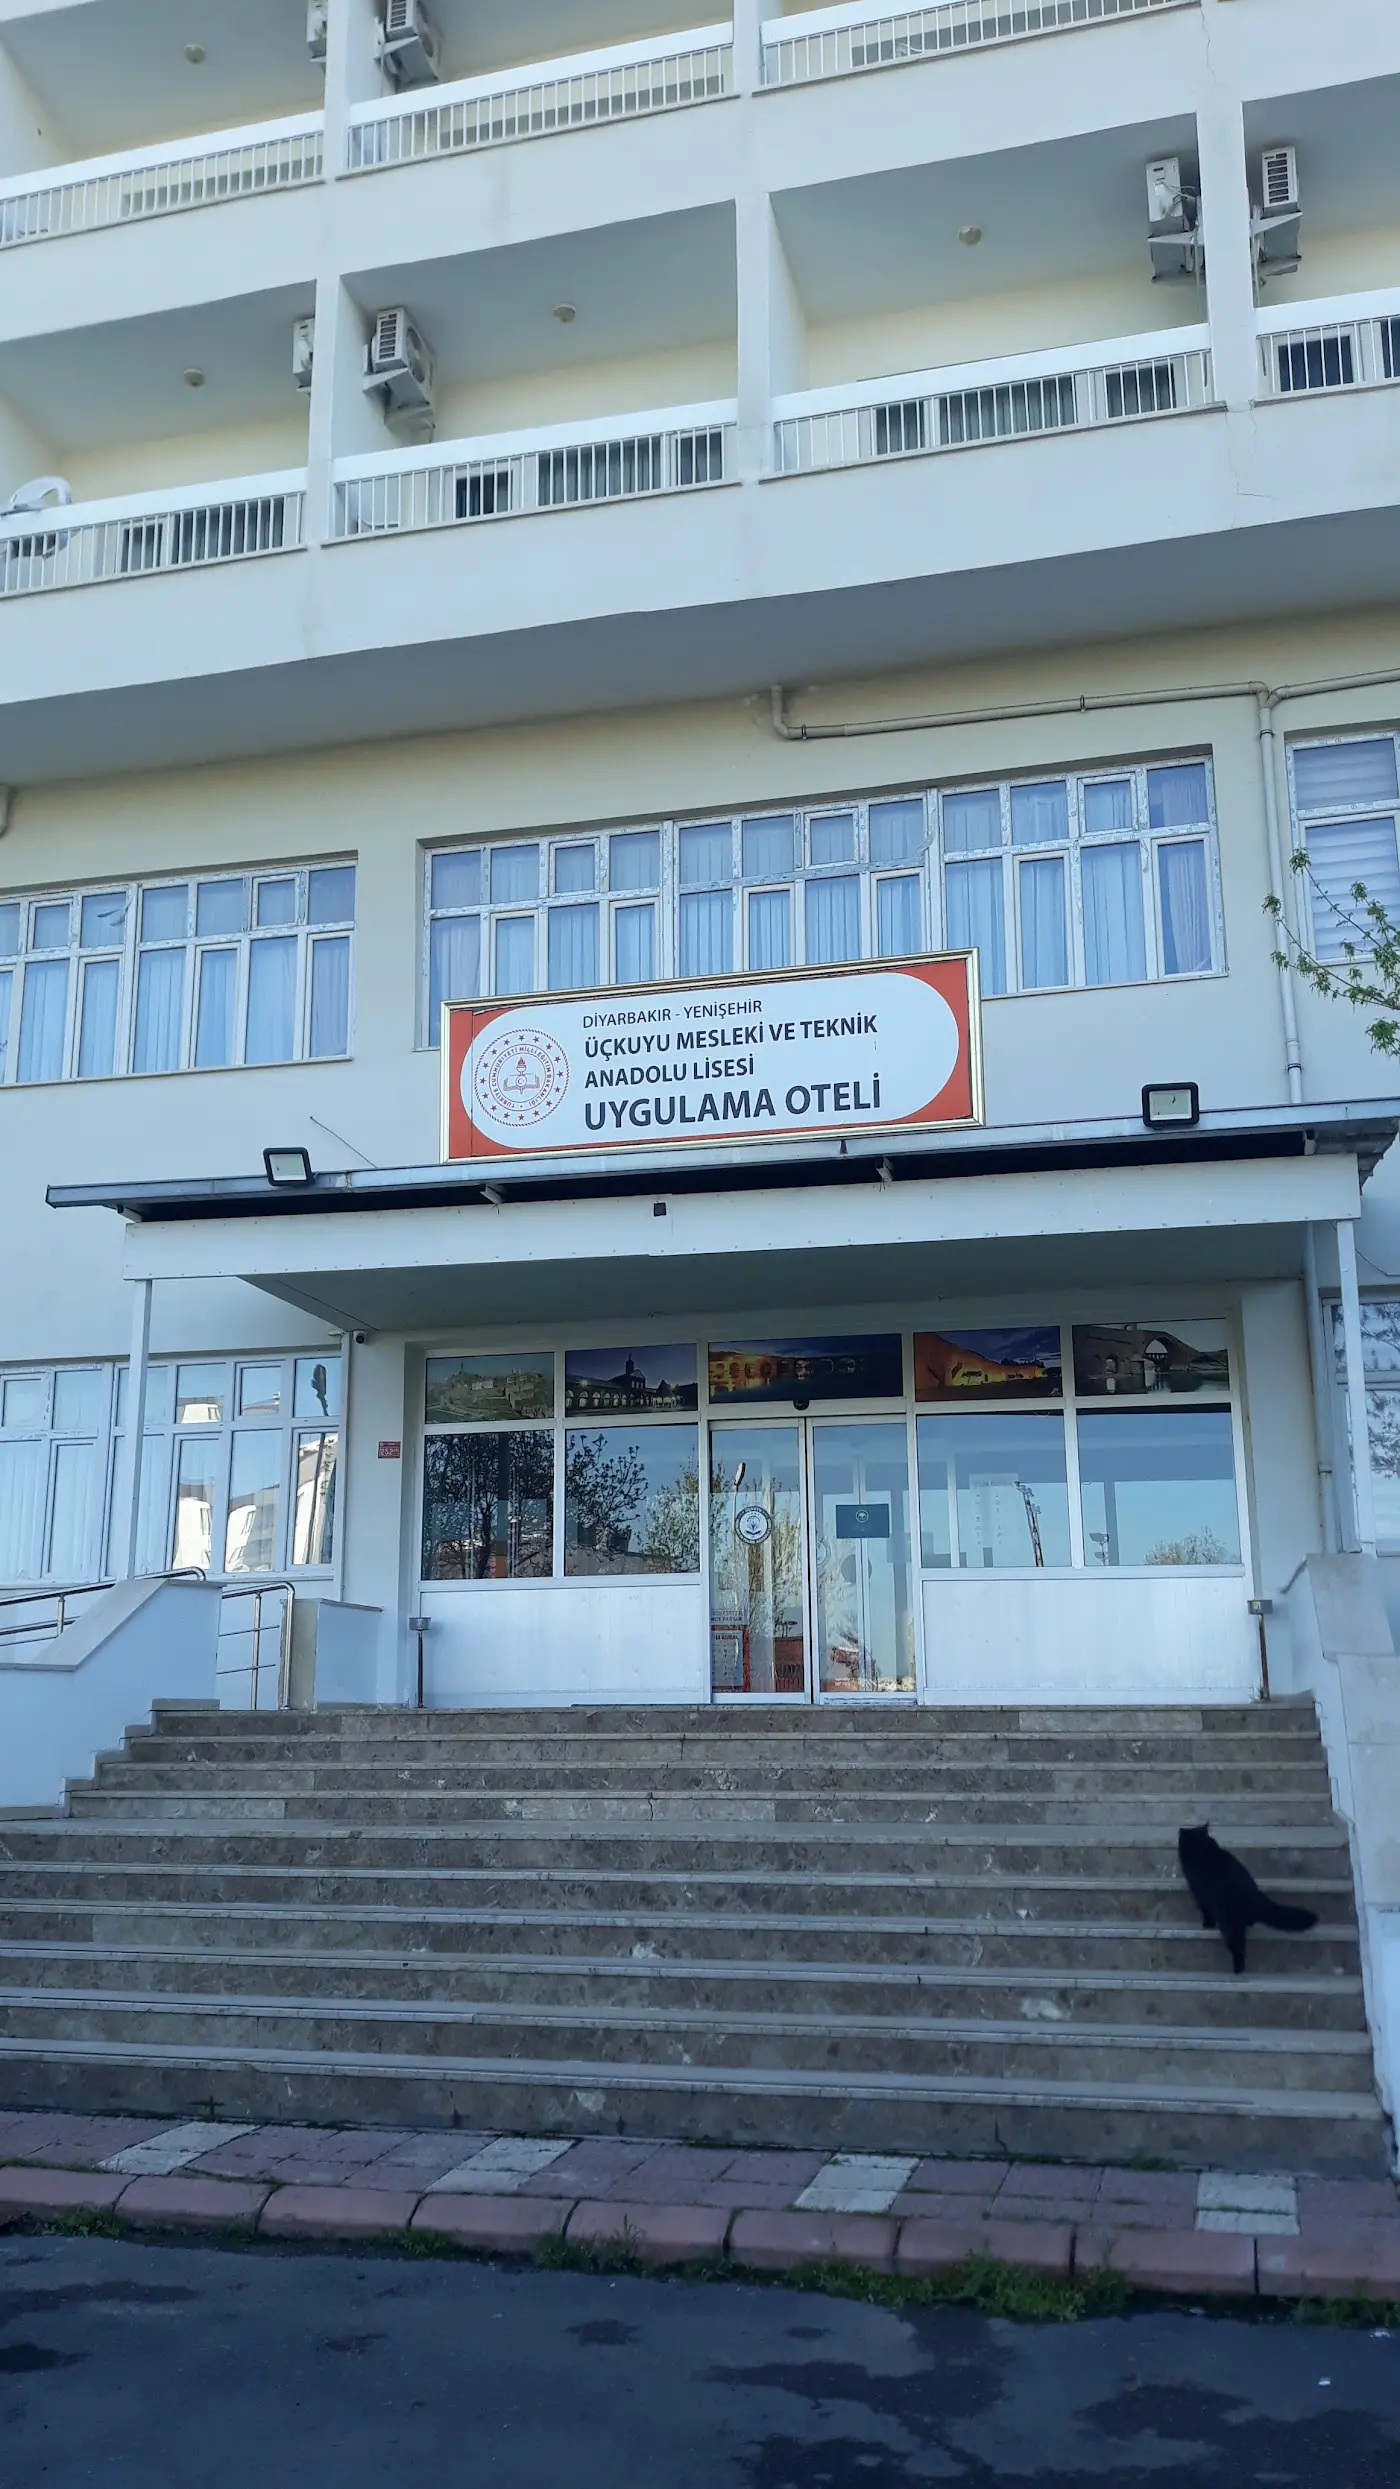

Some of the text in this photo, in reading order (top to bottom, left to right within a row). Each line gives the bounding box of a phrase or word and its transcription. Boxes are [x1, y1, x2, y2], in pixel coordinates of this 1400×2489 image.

[583, 1008, 671, 1028] DİYARBAKIR
[684, 998, 762, 1019] YENİŞEHİR
[585, 1012, 877, 1061] ÜÇKUYU MESLEKİ VE TEKNİK
[585, 1053, 754, 1088] ANADOLU LİSESİ
[585, 1072, 880, 1130] UYGULAMA OTELİ
